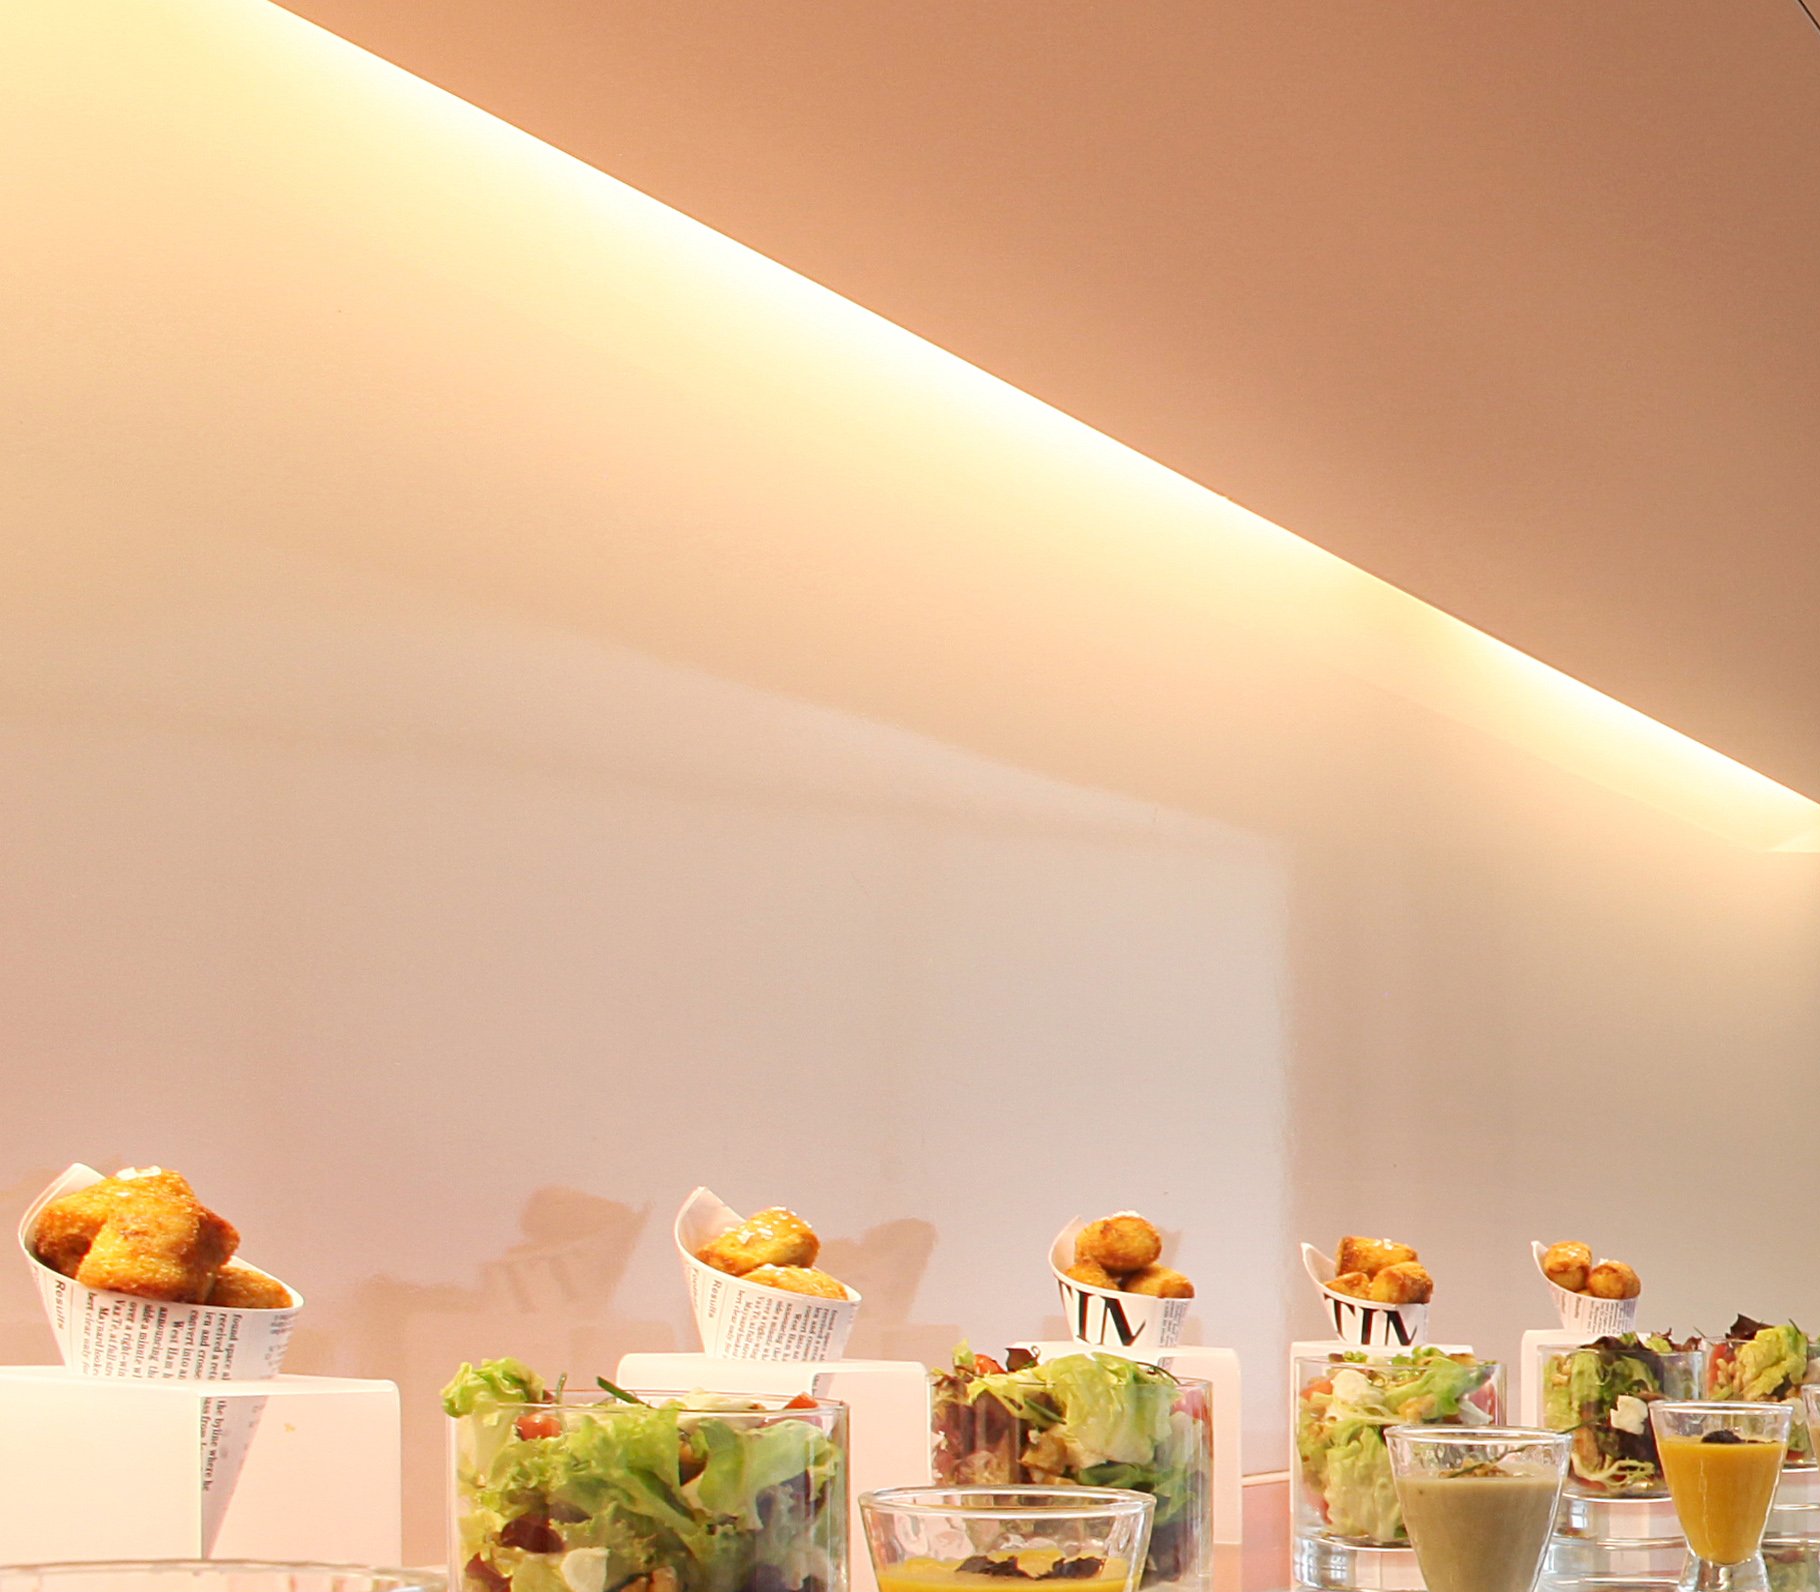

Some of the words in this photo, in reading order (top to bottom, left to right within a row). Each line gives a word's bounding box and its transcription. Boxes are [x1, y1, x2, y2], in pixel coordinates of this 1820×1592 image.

[54, 1279, 67, 1330] Results
[125, 1301, 138, 1323] over
[82, 1312, 96, 1337] clear
[94, 1307, 110, 1348] Maynard
[148, 1305, 169, 1362] announcing
[169, 1320, 186, 1344] West
[184, 1310, 200, 1346] convert
[212, 1312, 228, 1354] received
[199, 1329, 211, 1348] and
[105, 1343, 119, 1362] full
[164, 1347, 180, 1369] Ham
[182, 1347, 195, 1368] into
[216, 1399, 228, 1416] the
[210, 1417, 225, 1448] byline
[204, 1448, 219, 1478] where
[202, 1479, 215, 1492] he
